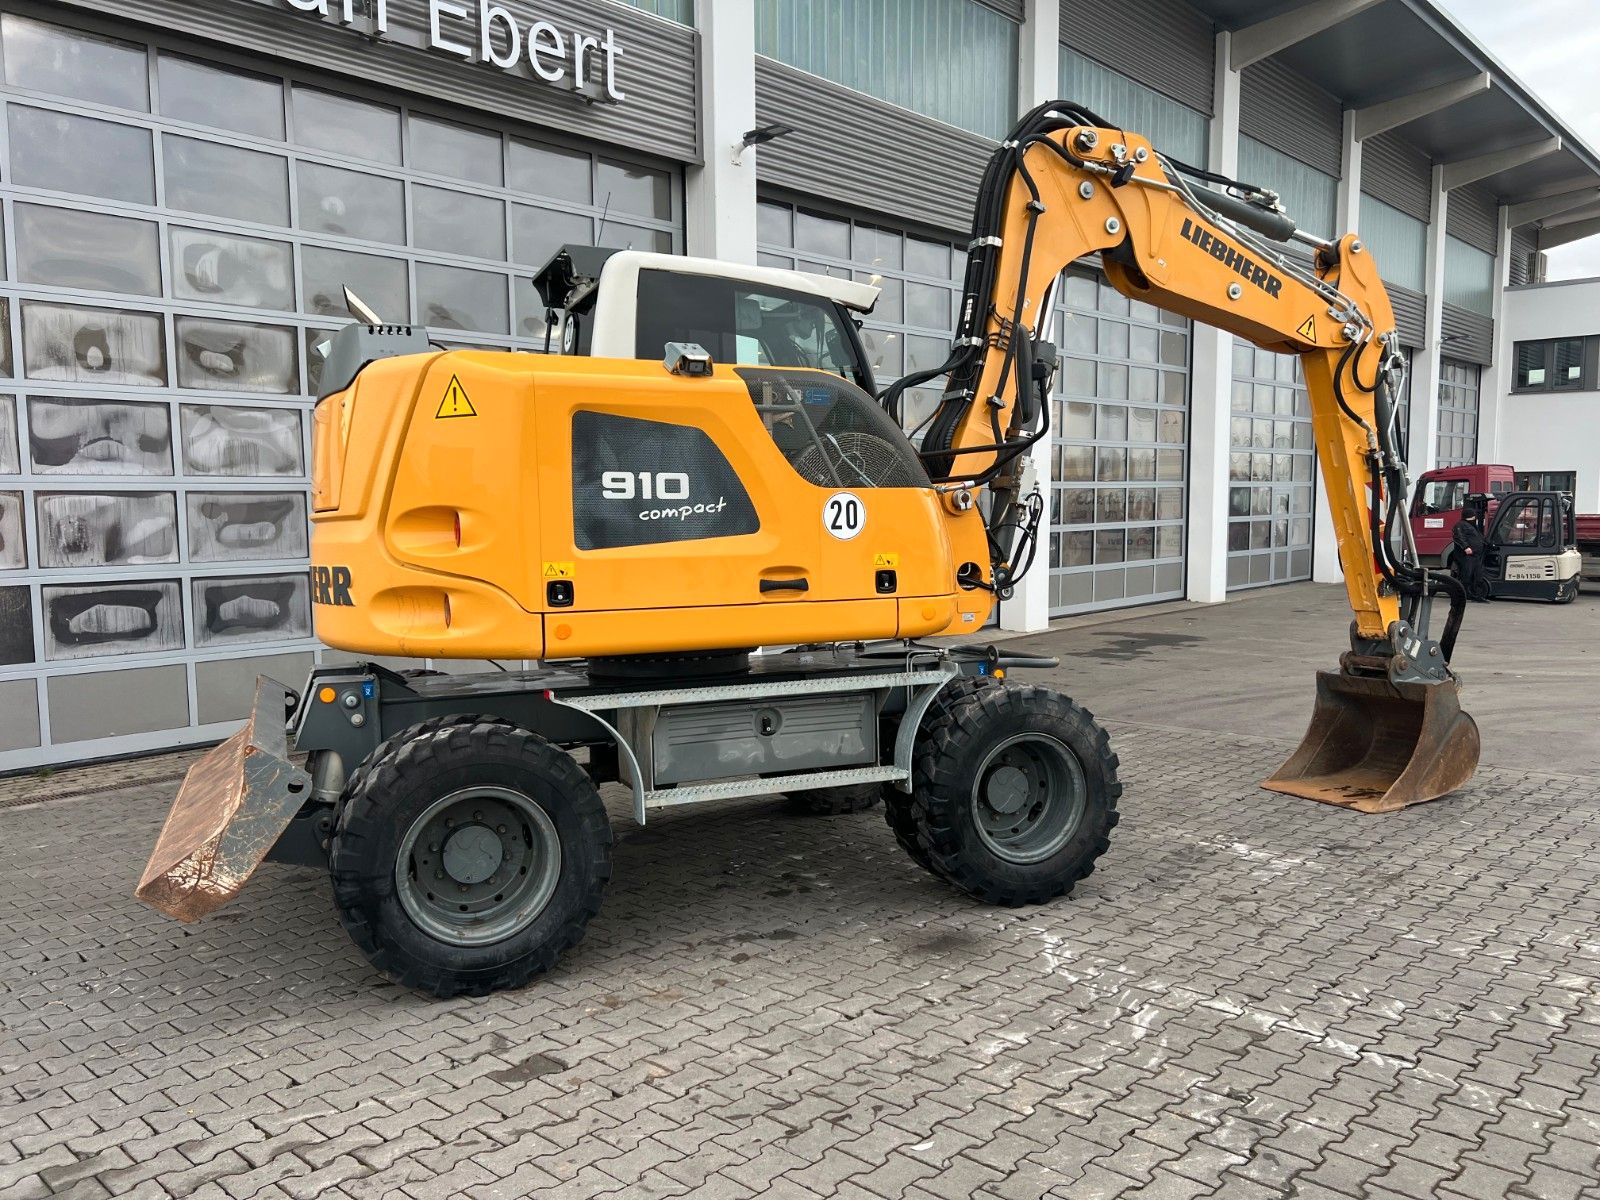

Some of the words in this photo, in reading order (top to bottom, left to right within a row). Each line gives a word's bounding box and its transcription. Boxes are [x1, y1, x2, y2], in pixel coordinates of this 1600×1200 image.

[430, 0, 625, 100] Ebert
[1180, 217, 1283, 300] LIEBHERR
[601, 471, 690, 500] 910
[638, 496, 727, 521] compact
[830, 499, 858, 530] 20
